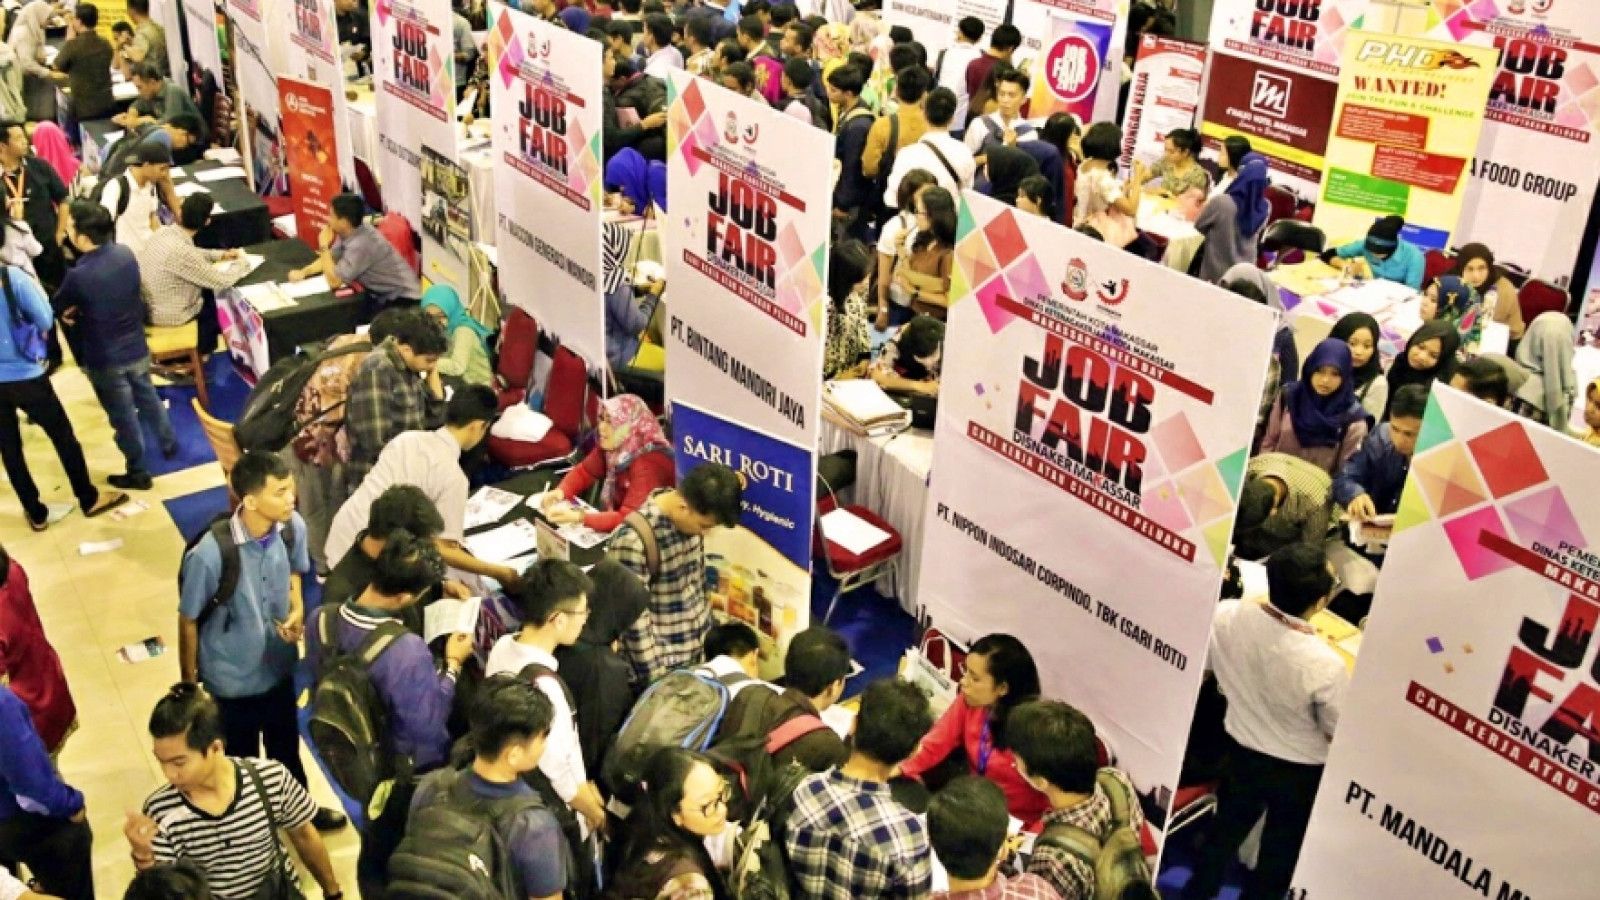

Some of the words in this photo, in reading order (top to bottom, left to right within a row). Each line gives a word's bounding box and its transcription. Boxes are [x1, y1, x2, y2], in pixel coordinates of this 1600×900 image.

[392, 20, 428, 60] JOB
[1250, 10, 1317, 51] FAIR
[393, 50, 430, 95] FAIR
[1355, 76, 1446, 98] WANTED!
[1487, 72, 1560, 113] AIR
[519, 82, 566, 135] JOB
[519, 117, 568, 177] FAIR
[708, 171, 777, 241] JOB
[1480, 160, 1520, 188] FOOD
[1522, 171, 1578, 203] GROUP
[707, 211, 777, 290] FAIR
[671, 315, 685, 343] PT.
[687, 326, 728, 373] BINTANG
[731, 357, 777, 408] MANDIRI
[778, 391, 805, 429] JAYA
[1032, 312, 1092, 349] MAKASSAR
[1094, 339, 1139, 371] CAREER
[1140, 361, 1164, 381] DAY
[1023, 331, 1155, 434] JOB
[684, 435, 732, 466] SARI
[740, 453, 794, 493] ROTI
[1015, 379, 1147, 495] FAIR
[753, 503, 796, 530] Hygienic
[971, 424, 997, 447] CARI
[1001, 438, 1034, 468] KERJA
[1036, 456, 1066, 486] ATAU
[1070, 477, 1129, 522] CIPTAKAN
[1133, 513, 1190, 558] PELUANG
[1532, 541, 1568, 565] DINAS
[937, 502, 950, 524] PT.
[952, 511, 987, 546] NIPPON
[989, 534, 1036, 576] INDOSARI
[1095, 600, 1119, 629] TBK
[1120, 616, 1152, 651] (SARI
[1153, 637, 1188, 672] ROTI)
[1414, 687, 1457, 724] CARI
[1463, 711, 1521, 760] KERJA
[1528, 754, 1579, 793] ATAU
[1345, 780, 1375, 819] PT.
[1380, 803, 1491, 897] MANDALA
